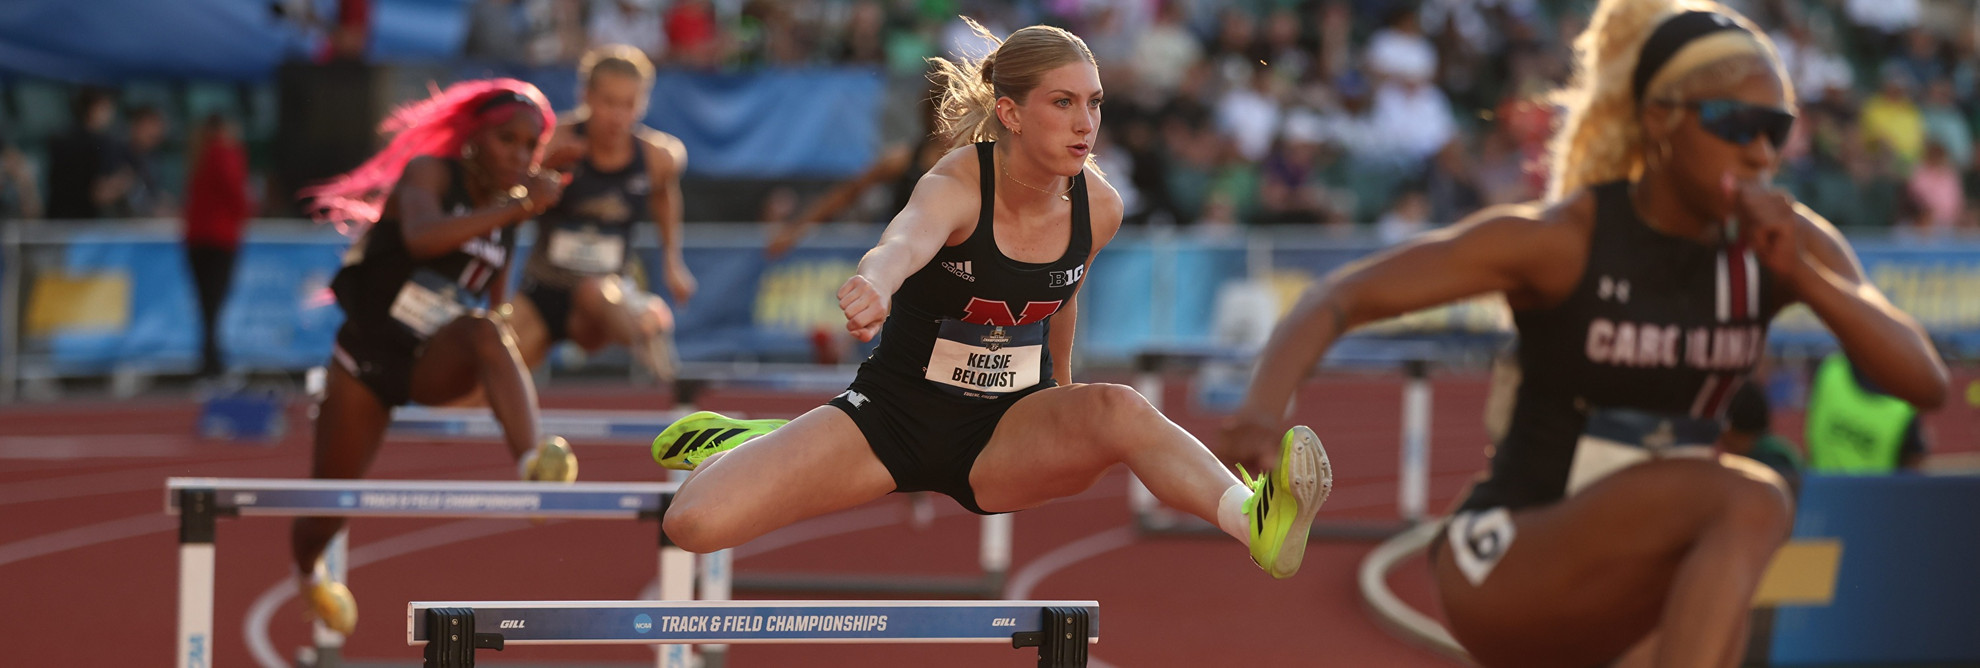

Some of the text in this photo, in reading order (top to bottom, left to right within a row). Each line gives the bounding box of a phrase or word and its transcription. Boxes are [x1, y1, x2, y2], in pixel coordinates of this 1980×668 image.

[941, 261, 975, 283] adidas
[967, 352, 1012, 370] KELSIE
[952, 367, 1016, 388] BELQUIST
[500, 619, 525, 629] GILL
[635, 622, 652, 630] NCAA
[661, 615, 888, 633] TRACK & FIELD CHAMPIONSHIPS
[991, 618, 1016, 627] GILL
